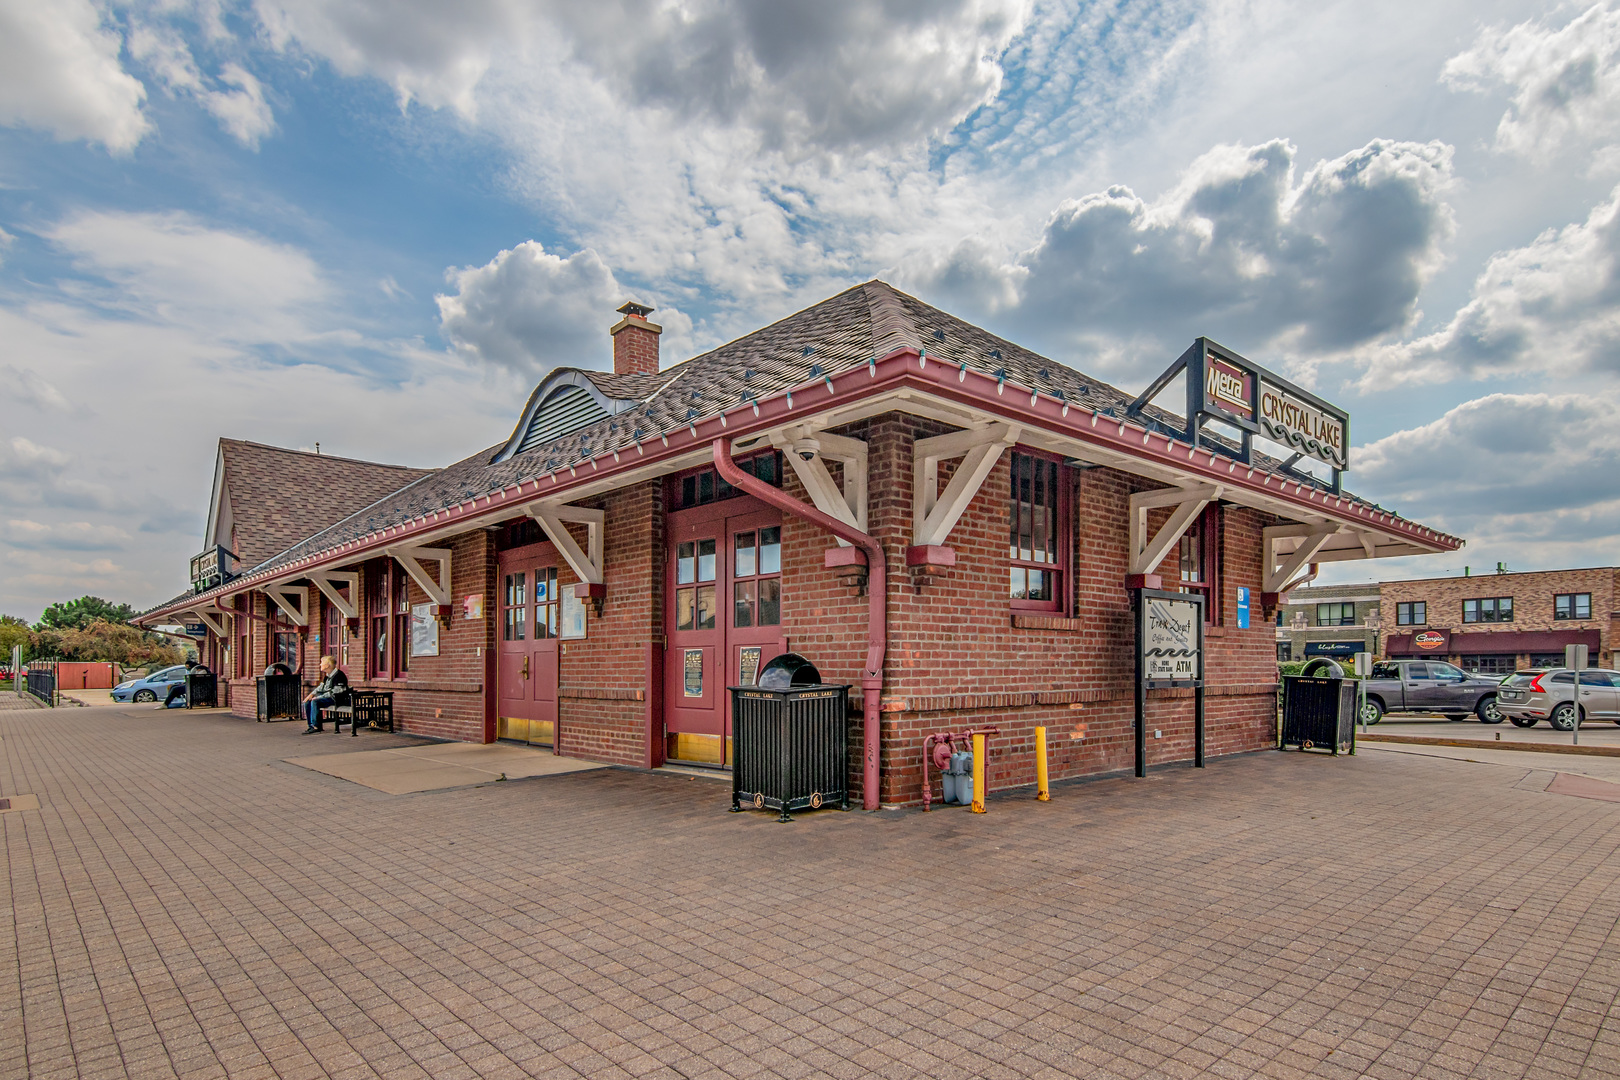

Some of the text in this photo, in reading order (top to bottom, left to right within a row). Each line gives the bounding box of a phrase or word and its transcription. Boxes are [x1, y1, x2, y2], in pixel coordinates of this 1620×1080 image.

[1207, 367, 1244, 400] Metra
[1262, 393, 1340, 448] CRYSTAL LAKE
[1170, 618, 1191, 636] Depot
[1152, 634, 1165, 644] Coffee
[1176, 661, 1192, 672] ATM
